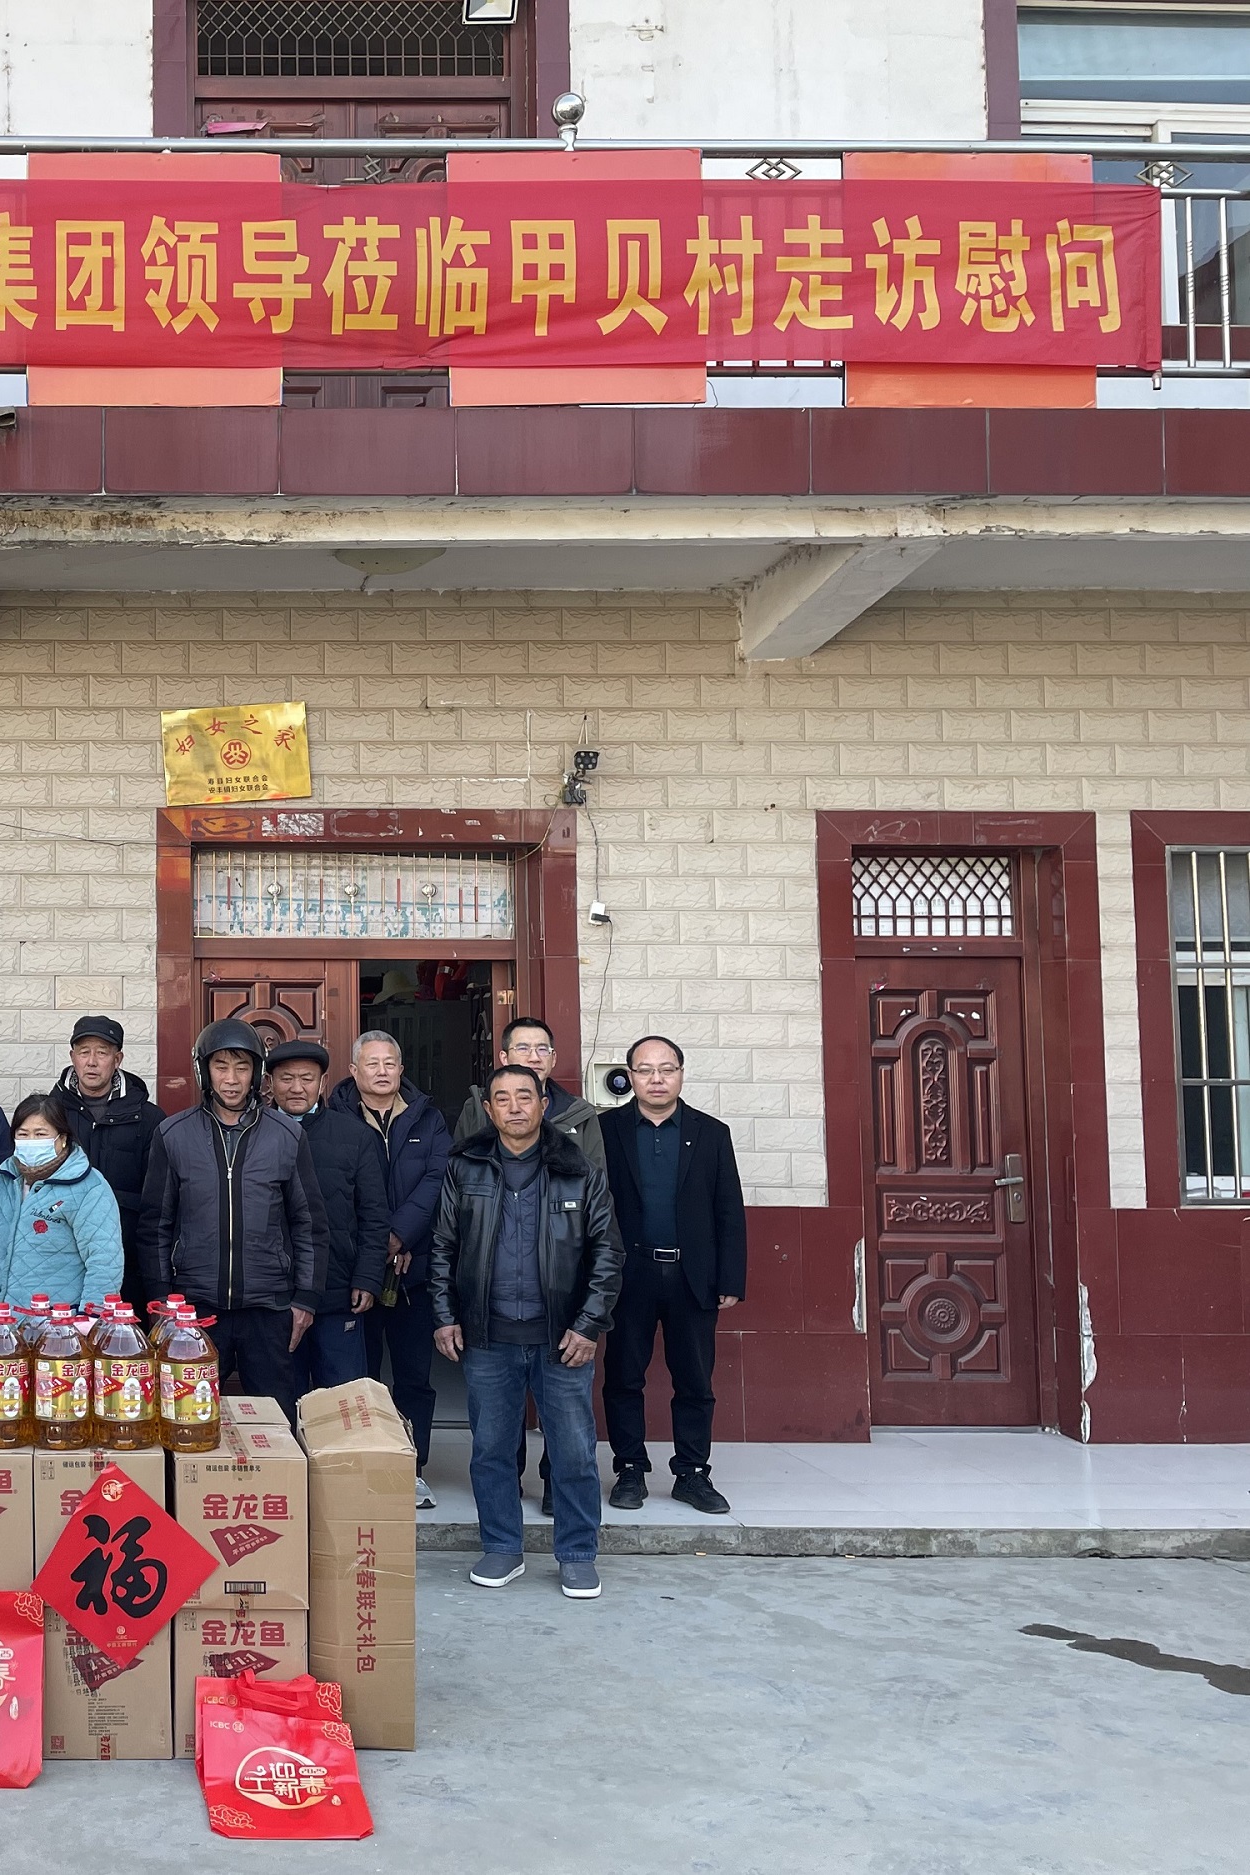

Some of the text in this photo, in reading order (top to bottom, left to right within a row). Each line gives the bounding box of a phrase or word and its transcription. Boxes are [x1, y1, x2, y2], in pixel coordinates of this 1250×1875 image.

[175, 713, 297, 756] 妇女之家
[111, 1362, 150, 1378] 金龙鱼
[182, 1364, 218, 1380] 金龙鱼
[203, 1493, 288, 1520] 金龙鱼
[224, 1526, 260, 1546] 1:1:1
[70, 1514, 168, 1617] 福
[356, 1526, 376, 1674] 工行春联大礼包
[202, 1620, 285, 1647] 金龙鱼
[203, 1696, 225, 1705] ICBC
[209, 1721, 230, 1730] ICBC
